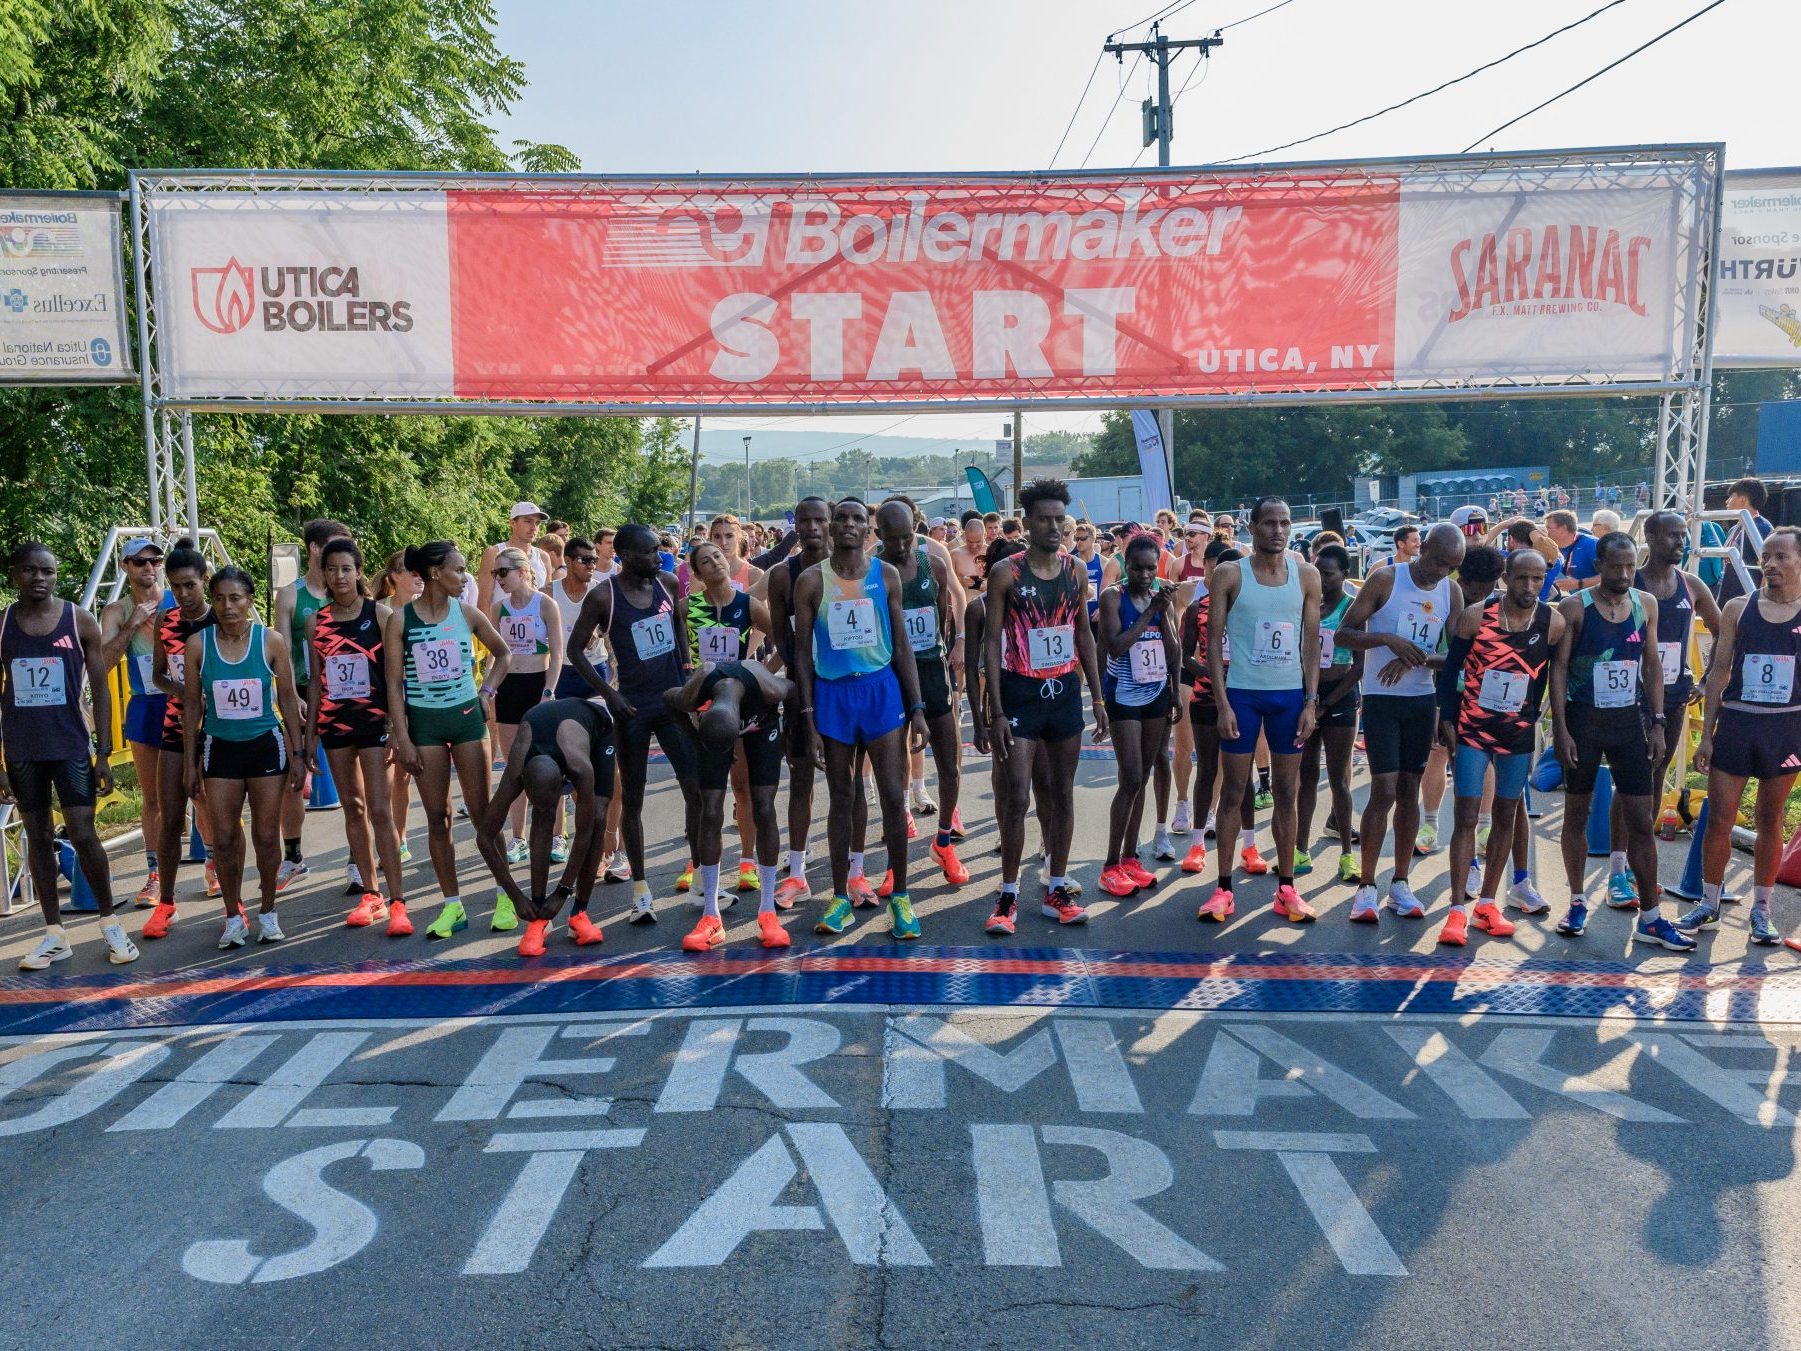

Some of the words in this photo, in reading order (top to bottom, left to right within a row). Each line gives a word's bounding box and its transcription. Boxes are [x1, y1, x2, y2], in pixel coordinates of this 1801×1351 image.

[784, 193, 1244, 266] Boilermaker
[260, 266, 360, 297] UTICA
[1448, 224, 1652, 324] SARANAC
[263, 301, 414, 333] BOILERS
[1513, 303, 1537, 316] MATT
[1538, 301, 1584, 315] BREWING
[709, 286, 1137, 383] START
[1198, 346, 1319, 375] UTICA,
[1332, 344, 1381, 370] NY
[846, 609, 858, 630] 4
[906, 616, 926, 636] 10
[509, 623, 526, 639] 40
[645, 623, 665, 645] 16
[1271, 630, 1282, 650] 6
[1411, 622, 1429, 642] 14
[709, 635, 727, 653] 41
[1043, 635, 1063, 656] 13
[426, 648, 449, 670] 38
[1141, 648, 1158, 667] 31
[26, 666, 51, 688] 12
[177, 663, 185, 682] 3
[337, 663, 356, 682] 37
[1608, 669, 1629, 690] 53
[1761, 663, 1773, 684] 8
[227, 687, 250, 708] 49
[1502, 681, 1510, 701] 1
[182, 1122, 1409, 1286] START
